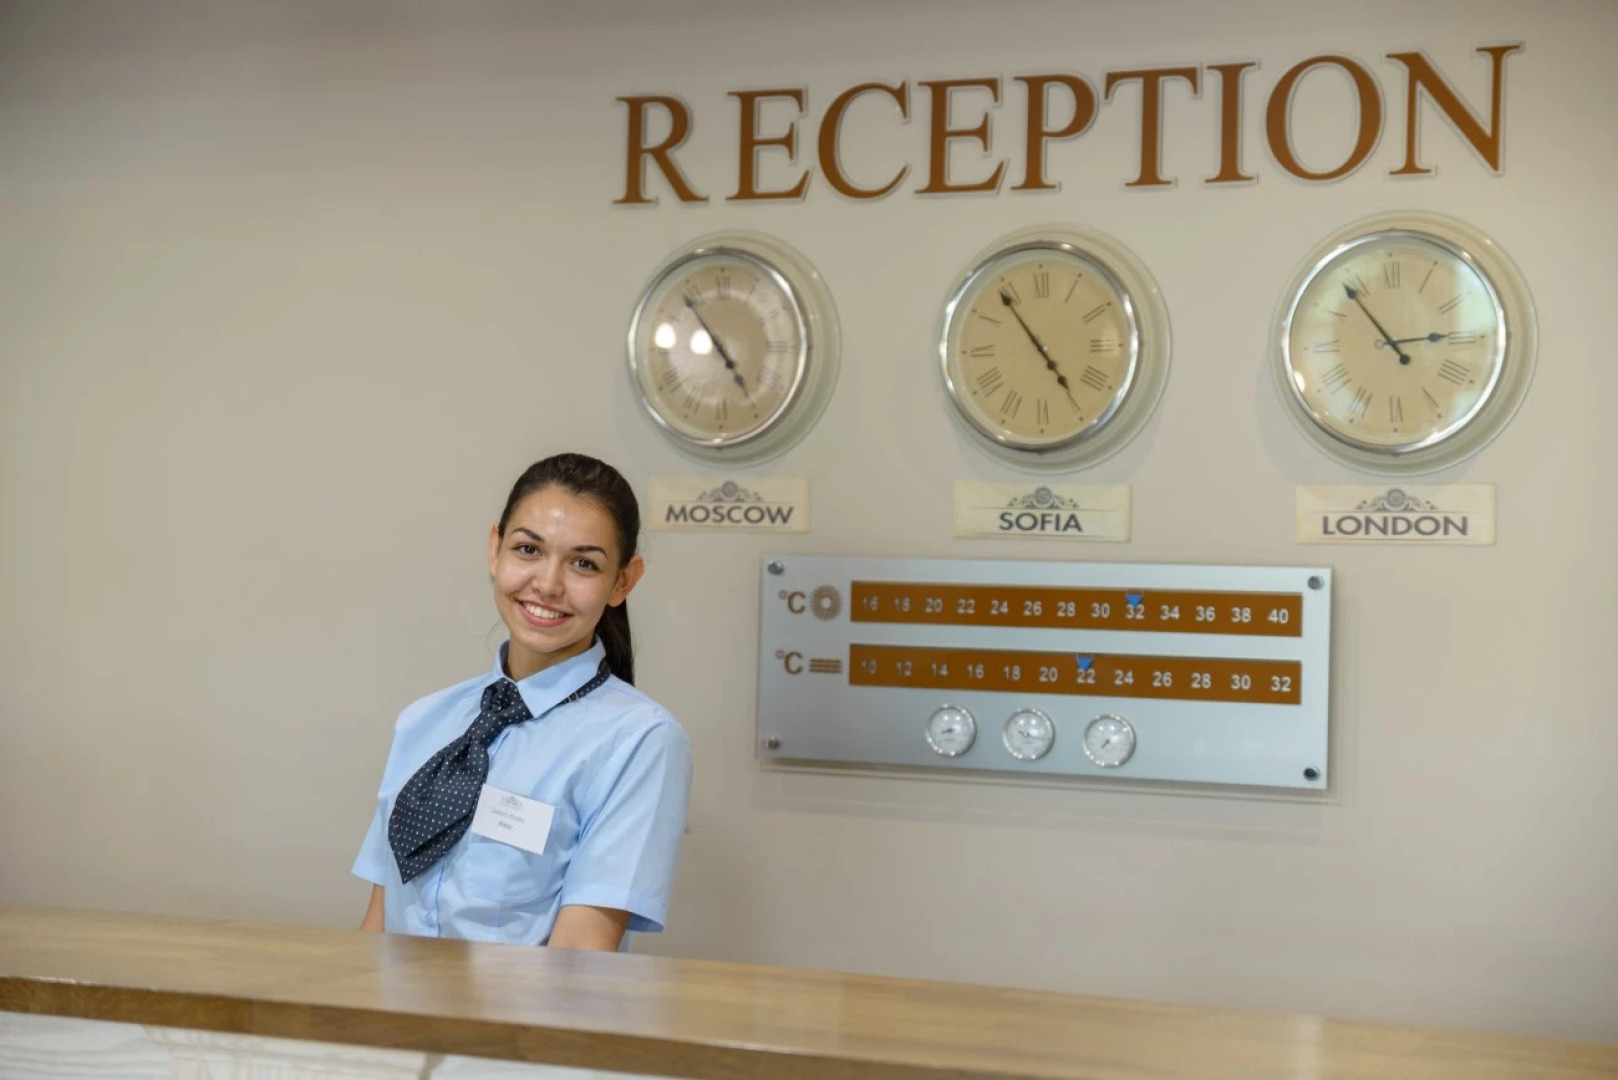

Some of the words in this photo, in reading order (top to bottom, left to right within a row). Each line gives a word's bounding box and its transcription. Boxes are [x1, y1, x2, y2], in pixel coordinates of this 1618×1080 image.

[612, 41, 1524, 206] RECEPTION
[665, 504, 795, 525] MOSCOW
[998, 511, 1084, 533] SOFIA
[1321, 514, 1470, 537] LONDON
[777, 589, 806, 614] °C
[924, 598, 943, 614] 20
[957, 599, 976, 614] 22
[990, 600, 1009, 615] 24
[1023, 601, 1043, 616] 26
[1056, 602, 1076, 618] 28
[1090, 603, 1110, 618] 30
[1125, 604, 1145, 620] 32
[1160, 605, 1181, 620] 34
[1195, 606, 1216, 622] 36
[1231, 607, 1252, 623] 38
[1267, 608, 1289, 624] 40
[775, 649, 804, 675] °C
[931, 662, 949, 677] 14
[966, 664, 985, 679] 16
[1003, 666, 1021, 681] 18
[1038, 667, 1058, 683] 20
[1076, 668, 1096, 684] 22
[1113, 670, 1134, 686] 24
[1152, 672, 1173, 688] 26
[1190, 673, 1212, 689] 28
[1231, 675, 1252, 690] 30
[1271, 676, 1292, 692] 32
